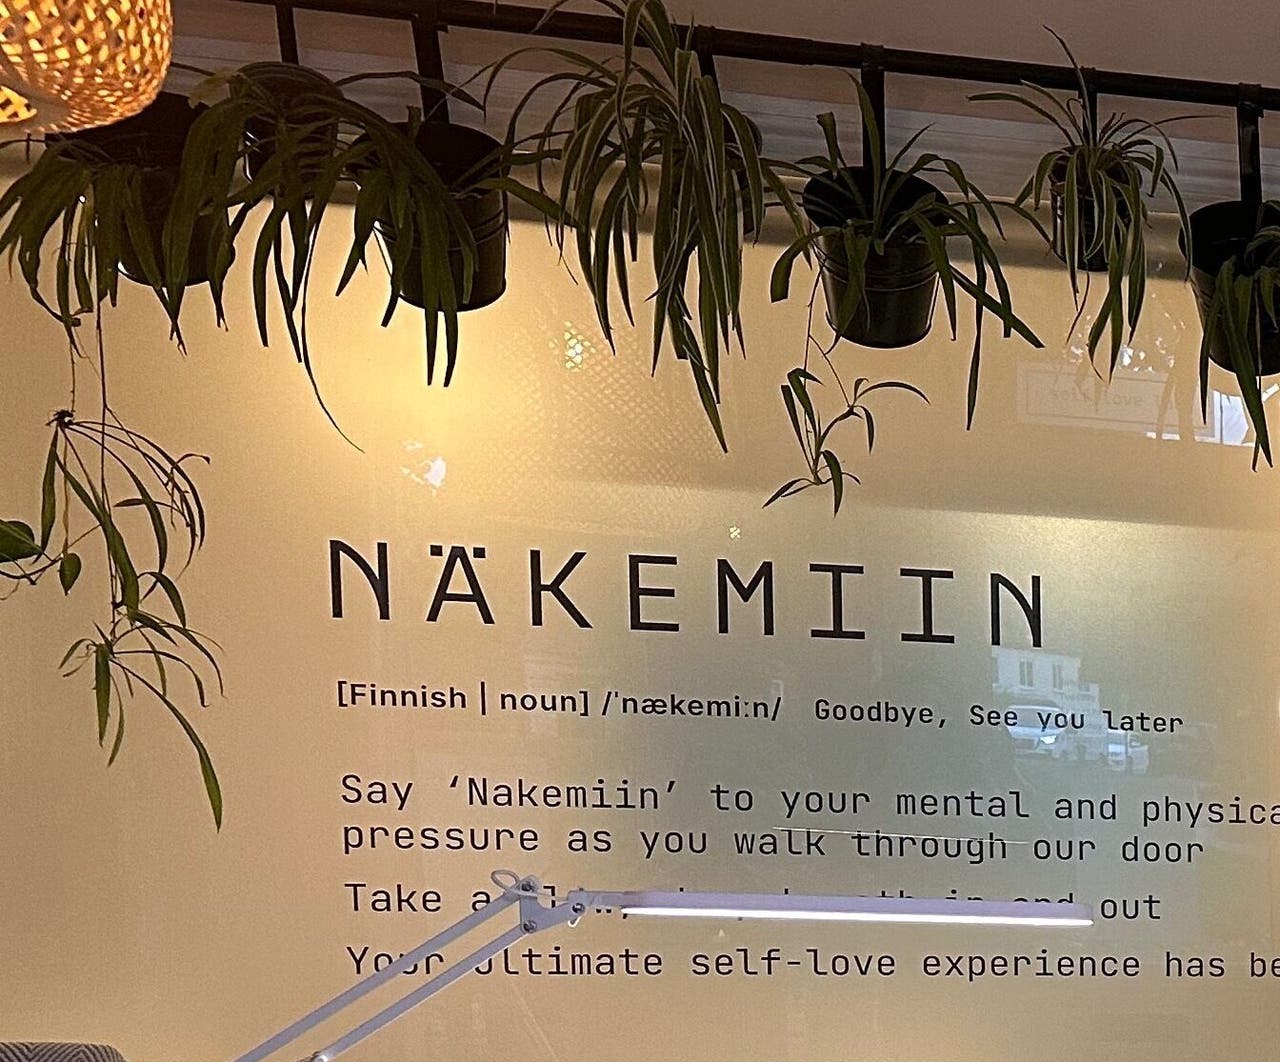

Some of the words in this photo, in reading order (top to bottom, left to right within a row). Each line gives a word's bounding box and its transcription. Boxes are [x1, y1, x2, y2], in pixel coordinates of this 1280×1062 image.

[330, 540, 1041, 648] NÄKEMIIN
[338, 681, 466, 708] [Finnish
[501, 691, 588, 716] noun]
[816, 699, 945, 728] Goodbye,
[970, 705, 1017, 726] See
[1037, 712, 1084, 731] you
[1103, 710, 1183, 732] later
[342, 775, 412, 810] Say
[711, 785, 752, 811] to
[781, 792, 870, 818] your
[897, 791, 1029, 817] mental
[1055, 794, 1116, 820] and
[344, 827, 538, 854] pressure
[568, 831, 611, 852] as
[640, 832, 706, 859] you
[734, 830, 825, 855] walk
[851, 830, 1006, 864] through
[1034, 840, 1095, 860] our
[1122, 836, 1203, 862] door
[344, 884, 440, 912] Take
[1101, 895, 1160, 919] out
[692, 949, 894, 975] self-love
[924, 949, 1139, 982] experience
[1166, 952, 1224, 977] has
